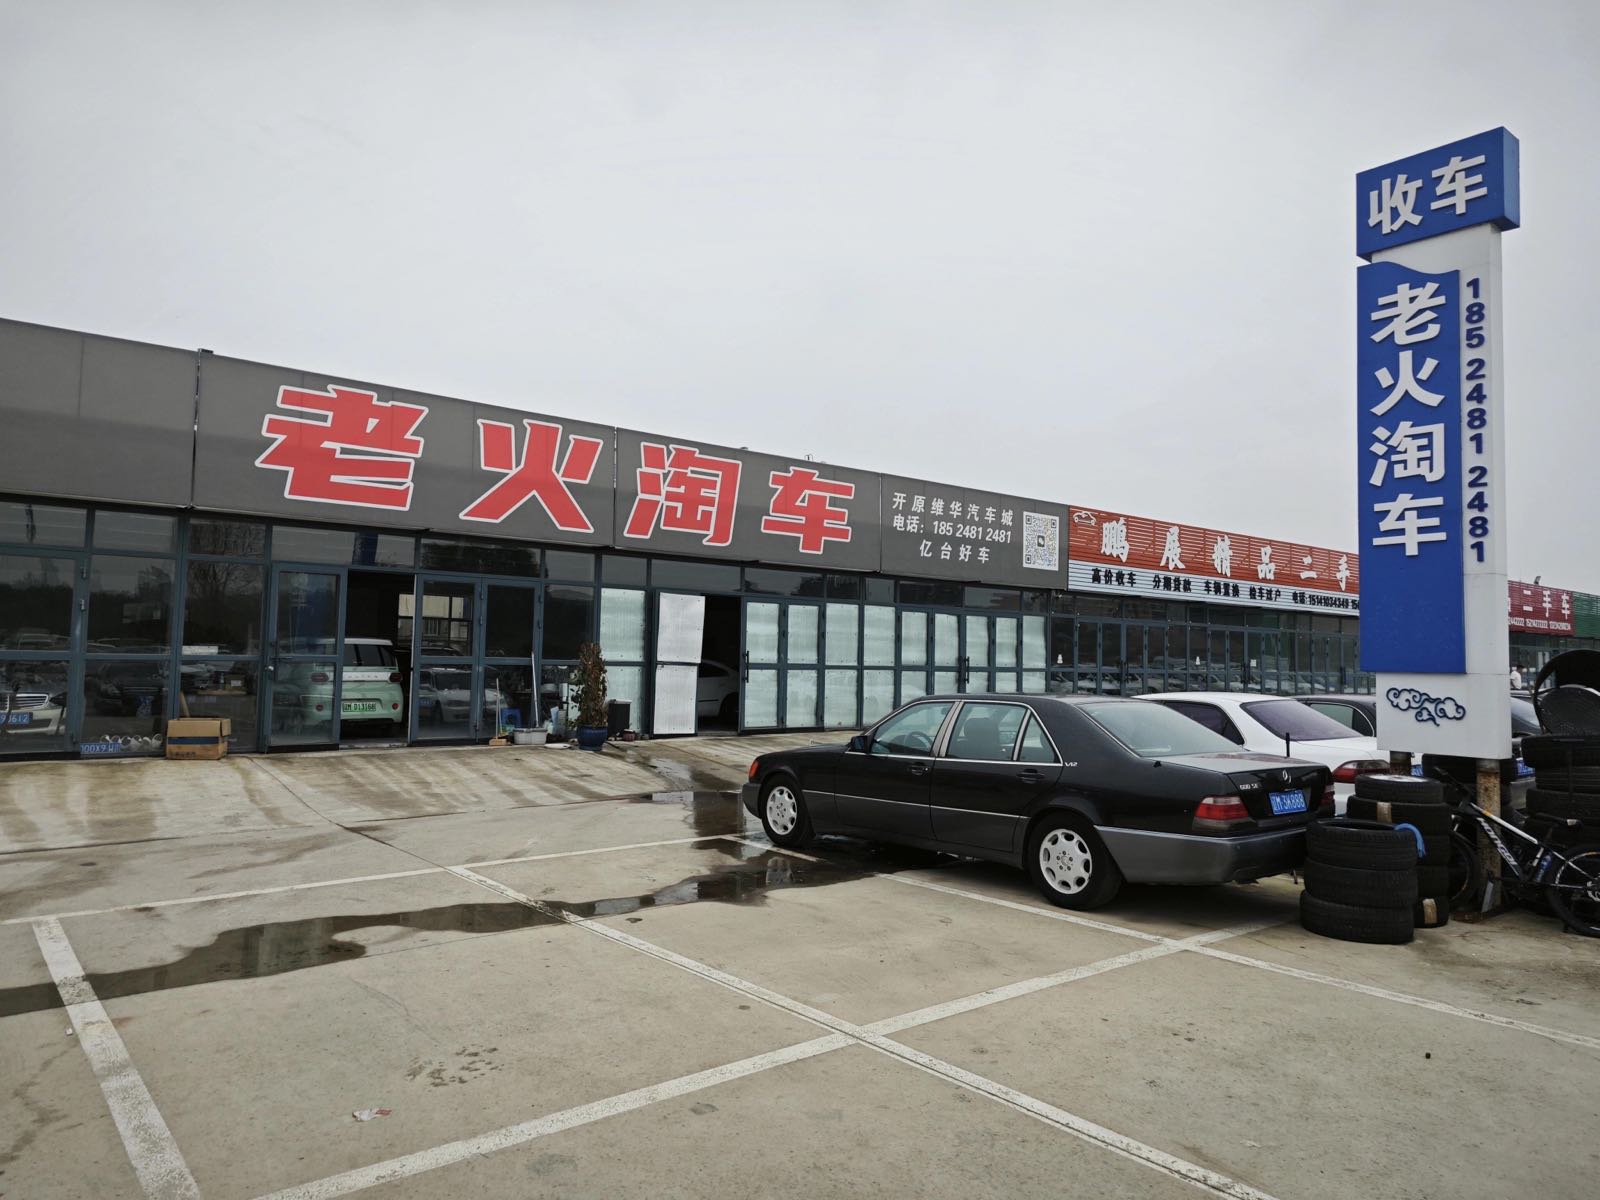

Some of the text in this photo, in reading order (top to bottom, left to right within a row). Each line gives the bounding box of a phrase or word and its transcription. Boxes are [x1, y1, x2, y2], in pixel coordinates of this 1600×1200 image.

[1367, 154, 1488, 235] 收车
[1369, 281, 1447, 557] 老火淘车
[1465, 277, 1490, 563] 185 2481 2481
[254, 383, 856, 555] 老火淘车
[892, 492, 1014, 527] 开原维华汽车城
[933, 520, 953, 536] 185
[955, 523, 983, 540] 2481
[985, 527, 1012, 544] 2481
[919, 539, 991, 564] 亿台好车
[1091, 567, 1137, 588] 高价收车
[1152, 573, 1192, 593] 分期贷款
[1203, 580, 1240, 598] 车辆置换
[1249, 585, 1282, 602] 检车过户
[1508, 589, 1571, 619] 二手车
